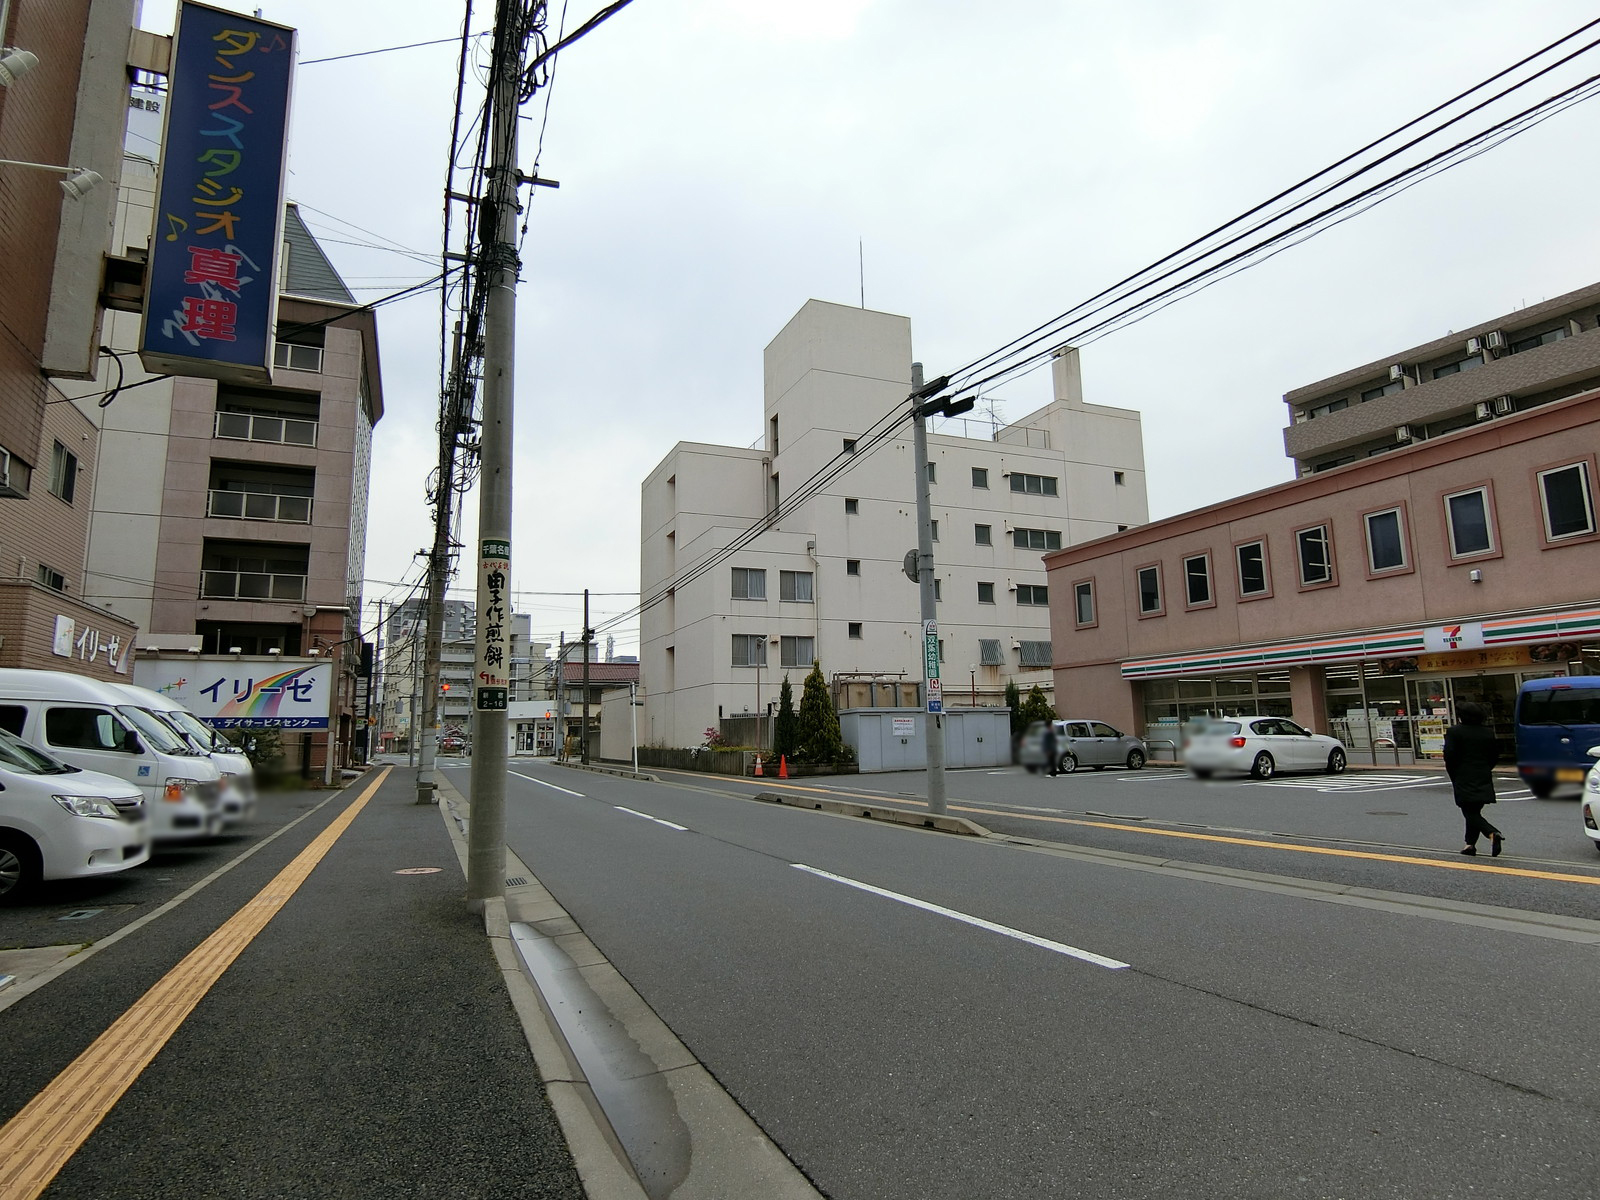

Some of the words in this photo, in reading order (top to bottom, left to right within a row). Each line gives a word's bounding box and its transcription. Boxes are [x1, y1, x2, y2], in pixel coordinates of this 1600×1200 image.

[192, 29, 261, 241] ダンススタジオ
[180, 245, 243, 342] 真理
[77, 626, 120, 667] イリーゼ
[199, 677, 316, 703] イリーゼ
